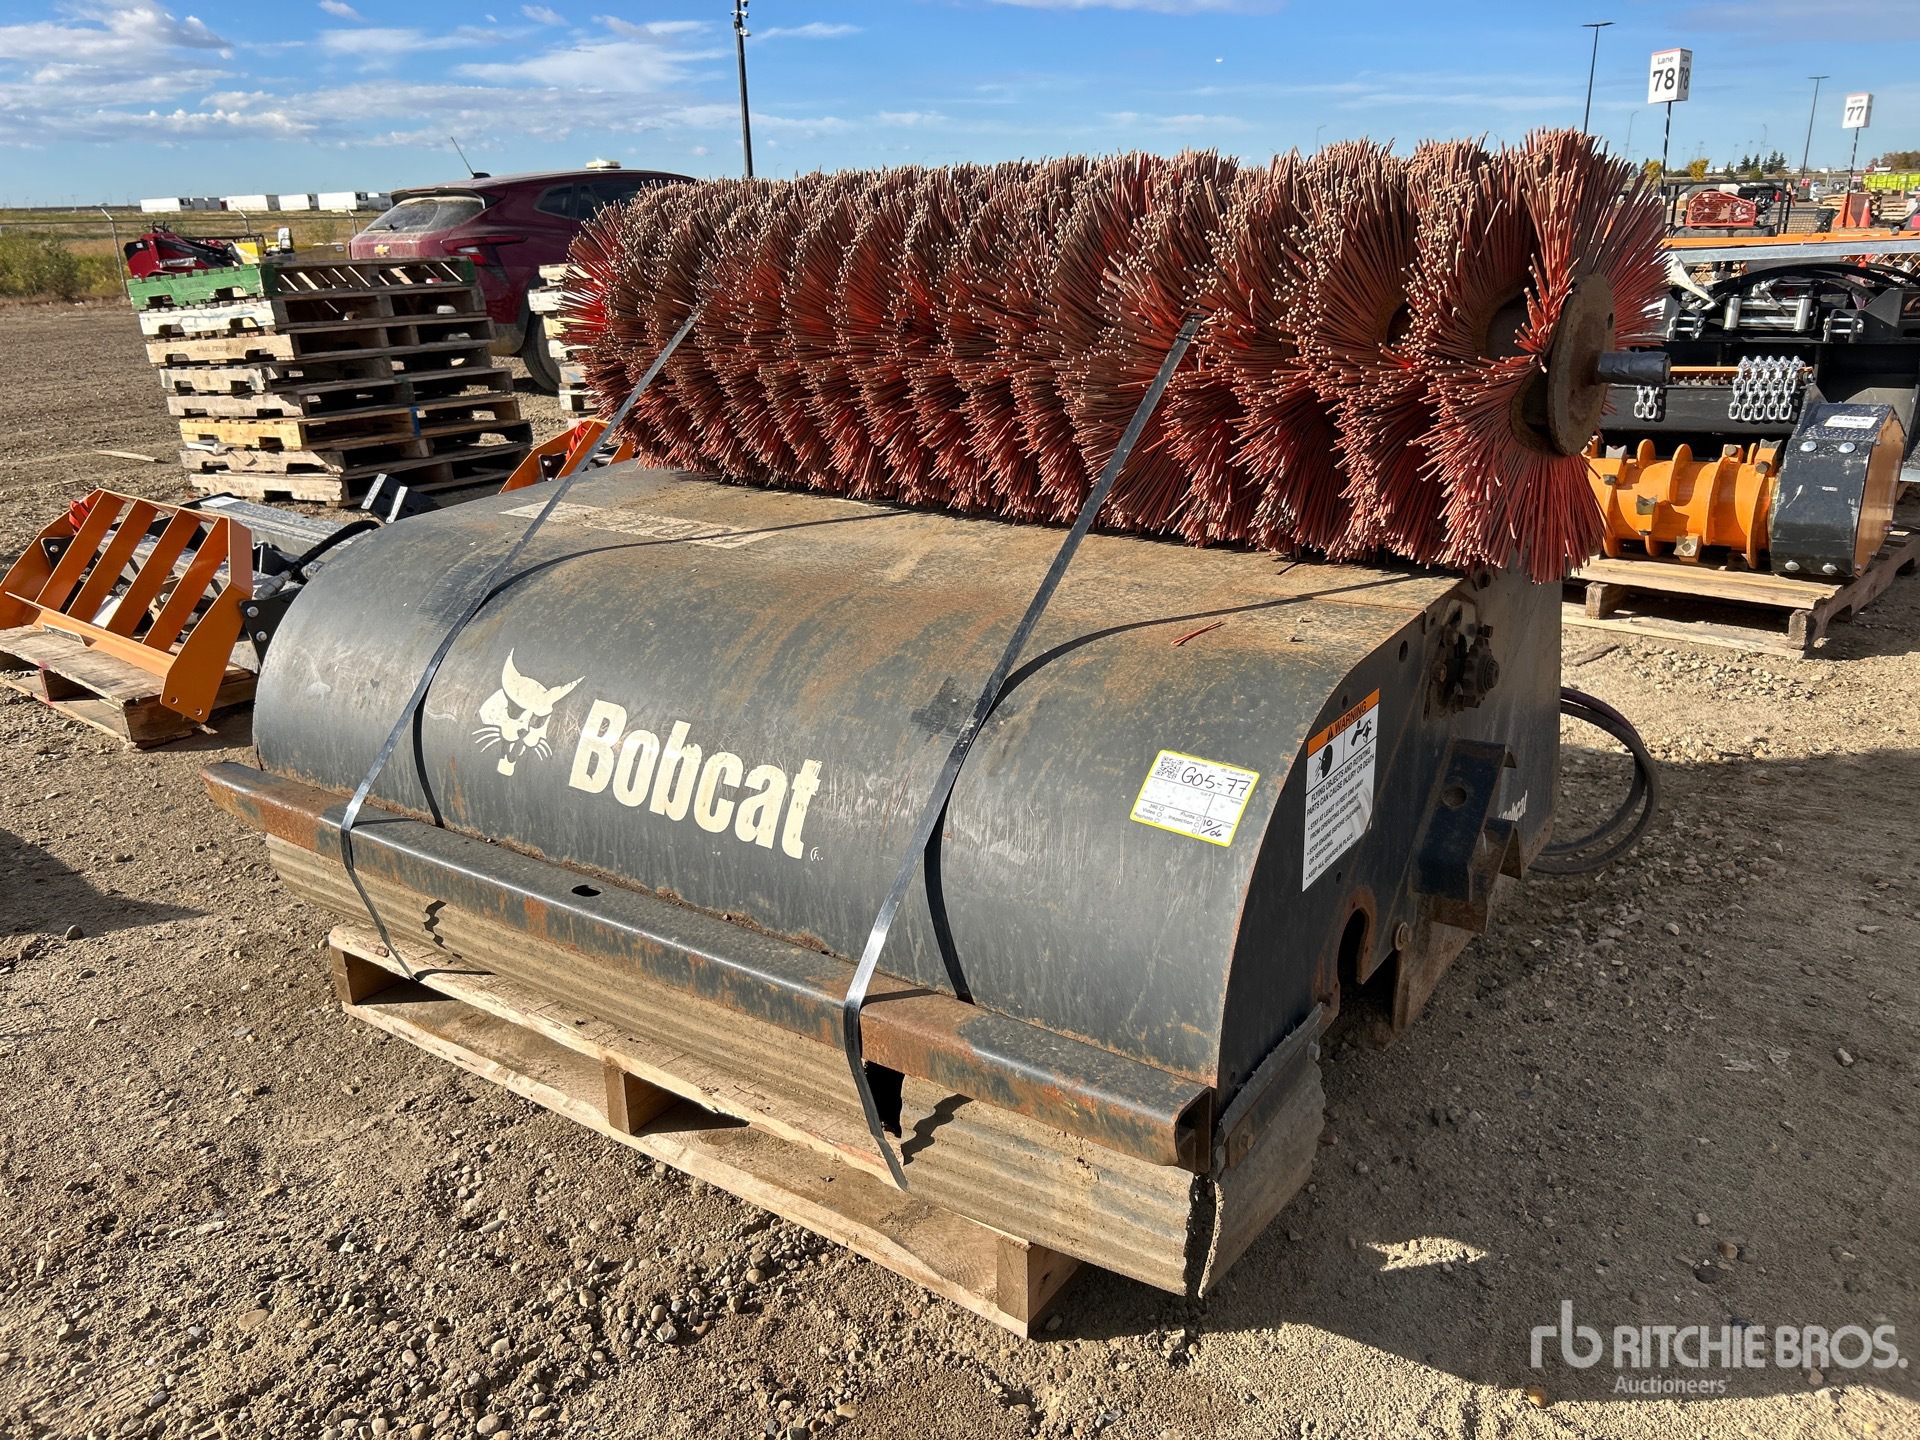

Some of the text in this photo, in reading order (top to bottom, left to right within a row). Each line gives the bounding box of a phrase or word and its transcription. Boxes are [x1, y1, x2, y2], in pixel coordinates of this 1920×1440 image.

[1657, 56, 1674, 65] Lane
[1652, 67, 1676, 92] 78
[1679, 66, 1690, 90] 78
[1847, 105, 1865, 121] 77
[1334, 700, 1367, 735] WARNING
[568, 698, 823, 860] Bobcat
[1307, 753, 1375, 818] PARTS CAN CAUSE INJURY OR DEATH
[1311, 746, 1371, 803] FLYING OBJECTS AND ROTATING
[1309, 826, 1321, 841] FROM
[1321, 809, 1340, 832] OPERATING
[1310, 818, 1319, 830] STAY
[1324, 803, 1335, 818] LEAST
[1309, 840, 1319, 855] STOP
[1318, 829, 1332, 846] ENGINE
[1331, 817, 1345, 834] BEFORE
[1308, 866, 1318, 878] KEEP
[1324, 845, 1339, 864] GUARDS
